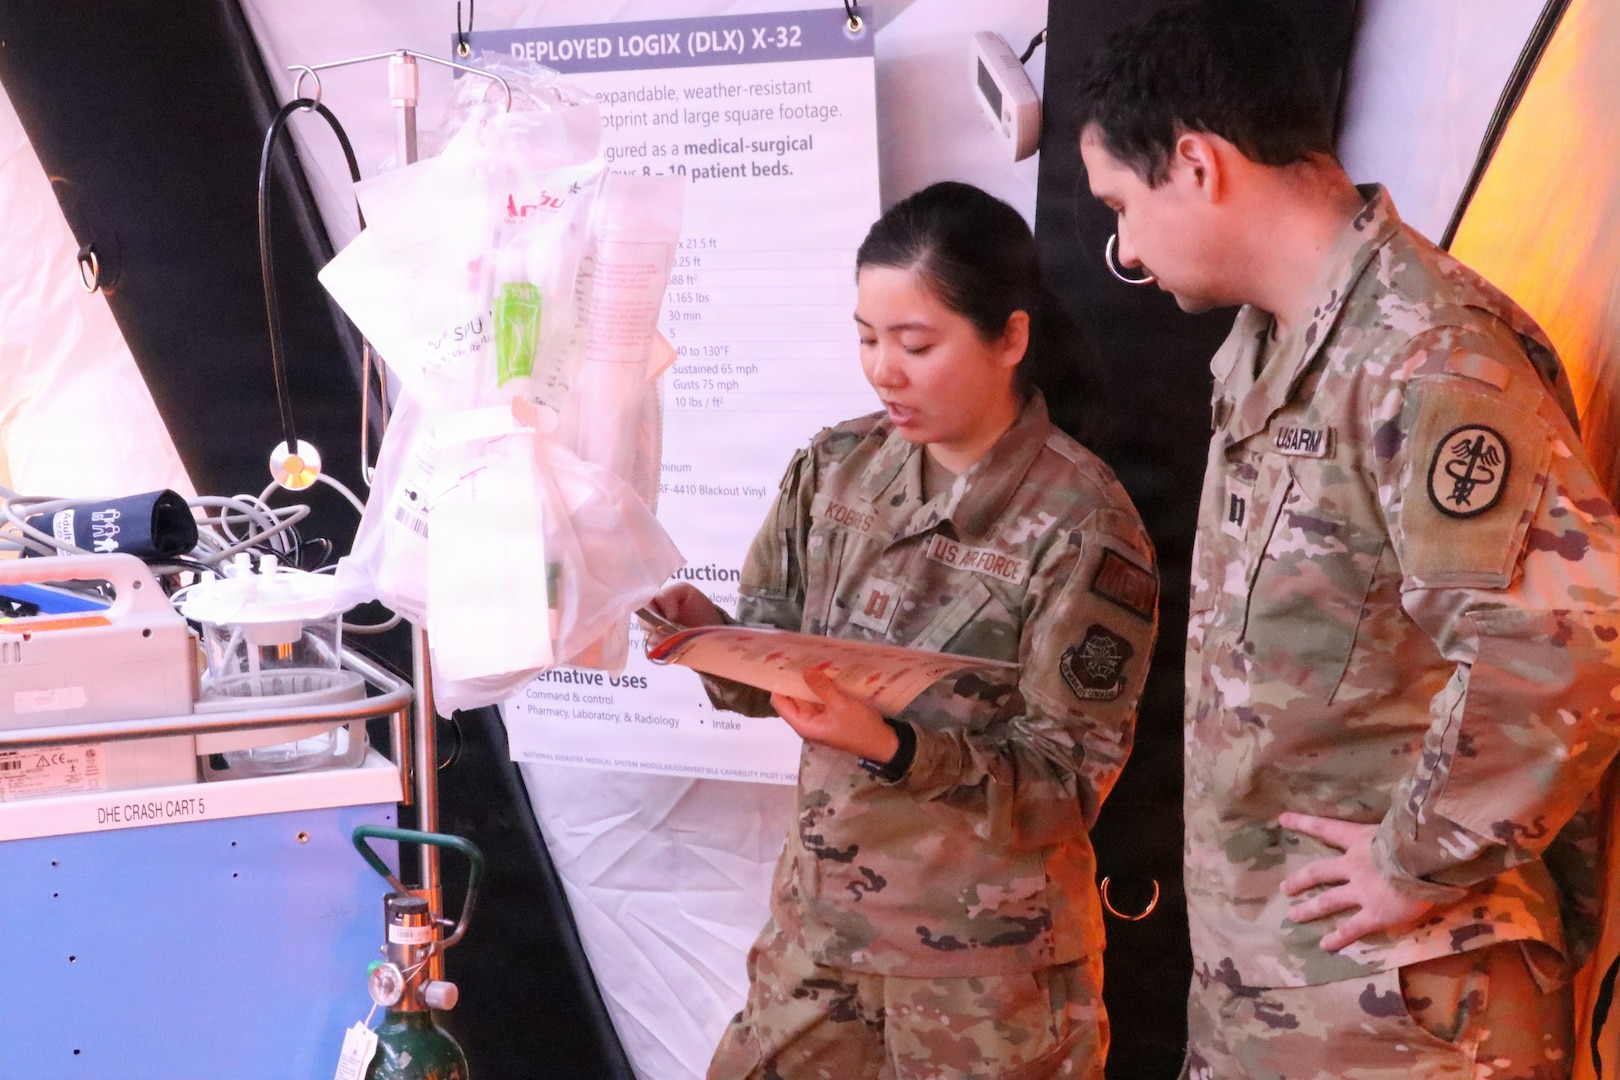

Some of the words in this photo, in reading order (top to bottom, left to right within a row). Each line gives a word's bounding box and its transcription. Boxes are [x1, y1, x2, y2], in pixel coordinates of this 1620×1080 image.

[510, 37, 612, 62] DEPLOYED
[618, 33, 681, 57] LOGIX
[687, 29, 745, 57] (DLX)
[751, 25, 802, 49] X-32
[595, 85, 679, 107] expandable,
[683, 79, 812, 100] weather-resistant
[652, 108, 679, 125] and
[684, 107, 720, 127] large
[724, 108, 774, 126] square
[779, 103, 842, 122] footage.
[604, 140, 647, 162] gured
[652, 144, 667, 156] as
[671, 144, 679, 156] a
[684, 134, 813, 156] medical-surgical
[692, 162, 747, 183] patient
[752, 160, 794, 178] beds.
[686, 238, 707, 249] 21.5
[709, 238, 717, 249] ft
[693, 256, 701, 267] ft
[668, 292, 693, 304] 1,165
[695, 292, 710, 303] lbs
[669, 310, 680, 321] 30
[683, 310, 701, 320] min
[670, 328, 676, 338] 5
[690, 347, 700, 356] to
[703, 345, 730, 356] 130°F
[672, 363, 718, 374] Sustained
[721, 364, 733, 374] 65
[735, 365, 758, 377] mph
[673, 379, 699, 390] Gusts
[702, 379, 714, 390] 75
[717, 379, 739, 392] mph
[675, 397, 686, 407] 10
[689, 397, 702, 407] lbs
[700, 485, 739, 496] Blackout
[742, 486, 766, 499] Vinyl
[62, 512, 72, 541] Adult
[976, 551, 1022, 580] FORCE
[535, 669, 603, 686] ernative
[526, 688, 570, 701] Command
[573, 692, 581, 702] &
[582, 695, 614, 705] control
[528, 704, 571, 720] Pharmacy,
[572, 708, 621, 724] Laboratory,
[624, 712, 632, 722] &
[634, 713, 680, 728] Radiology
[712, 719, 741, 731] Intake
[523, 751, 554, 761] NATIONAL
[555, 754, 584, 764] DISASTER
[614, 759, 639, 768] SYSTEM
[720, 768, 758, 778] CAPABILITY
[98, 806, 121, 824] DHE
[124, 802, 163, 821] CRASH
[166, 799, 195, 817] CART
[198, 798, 205, 814] 5
